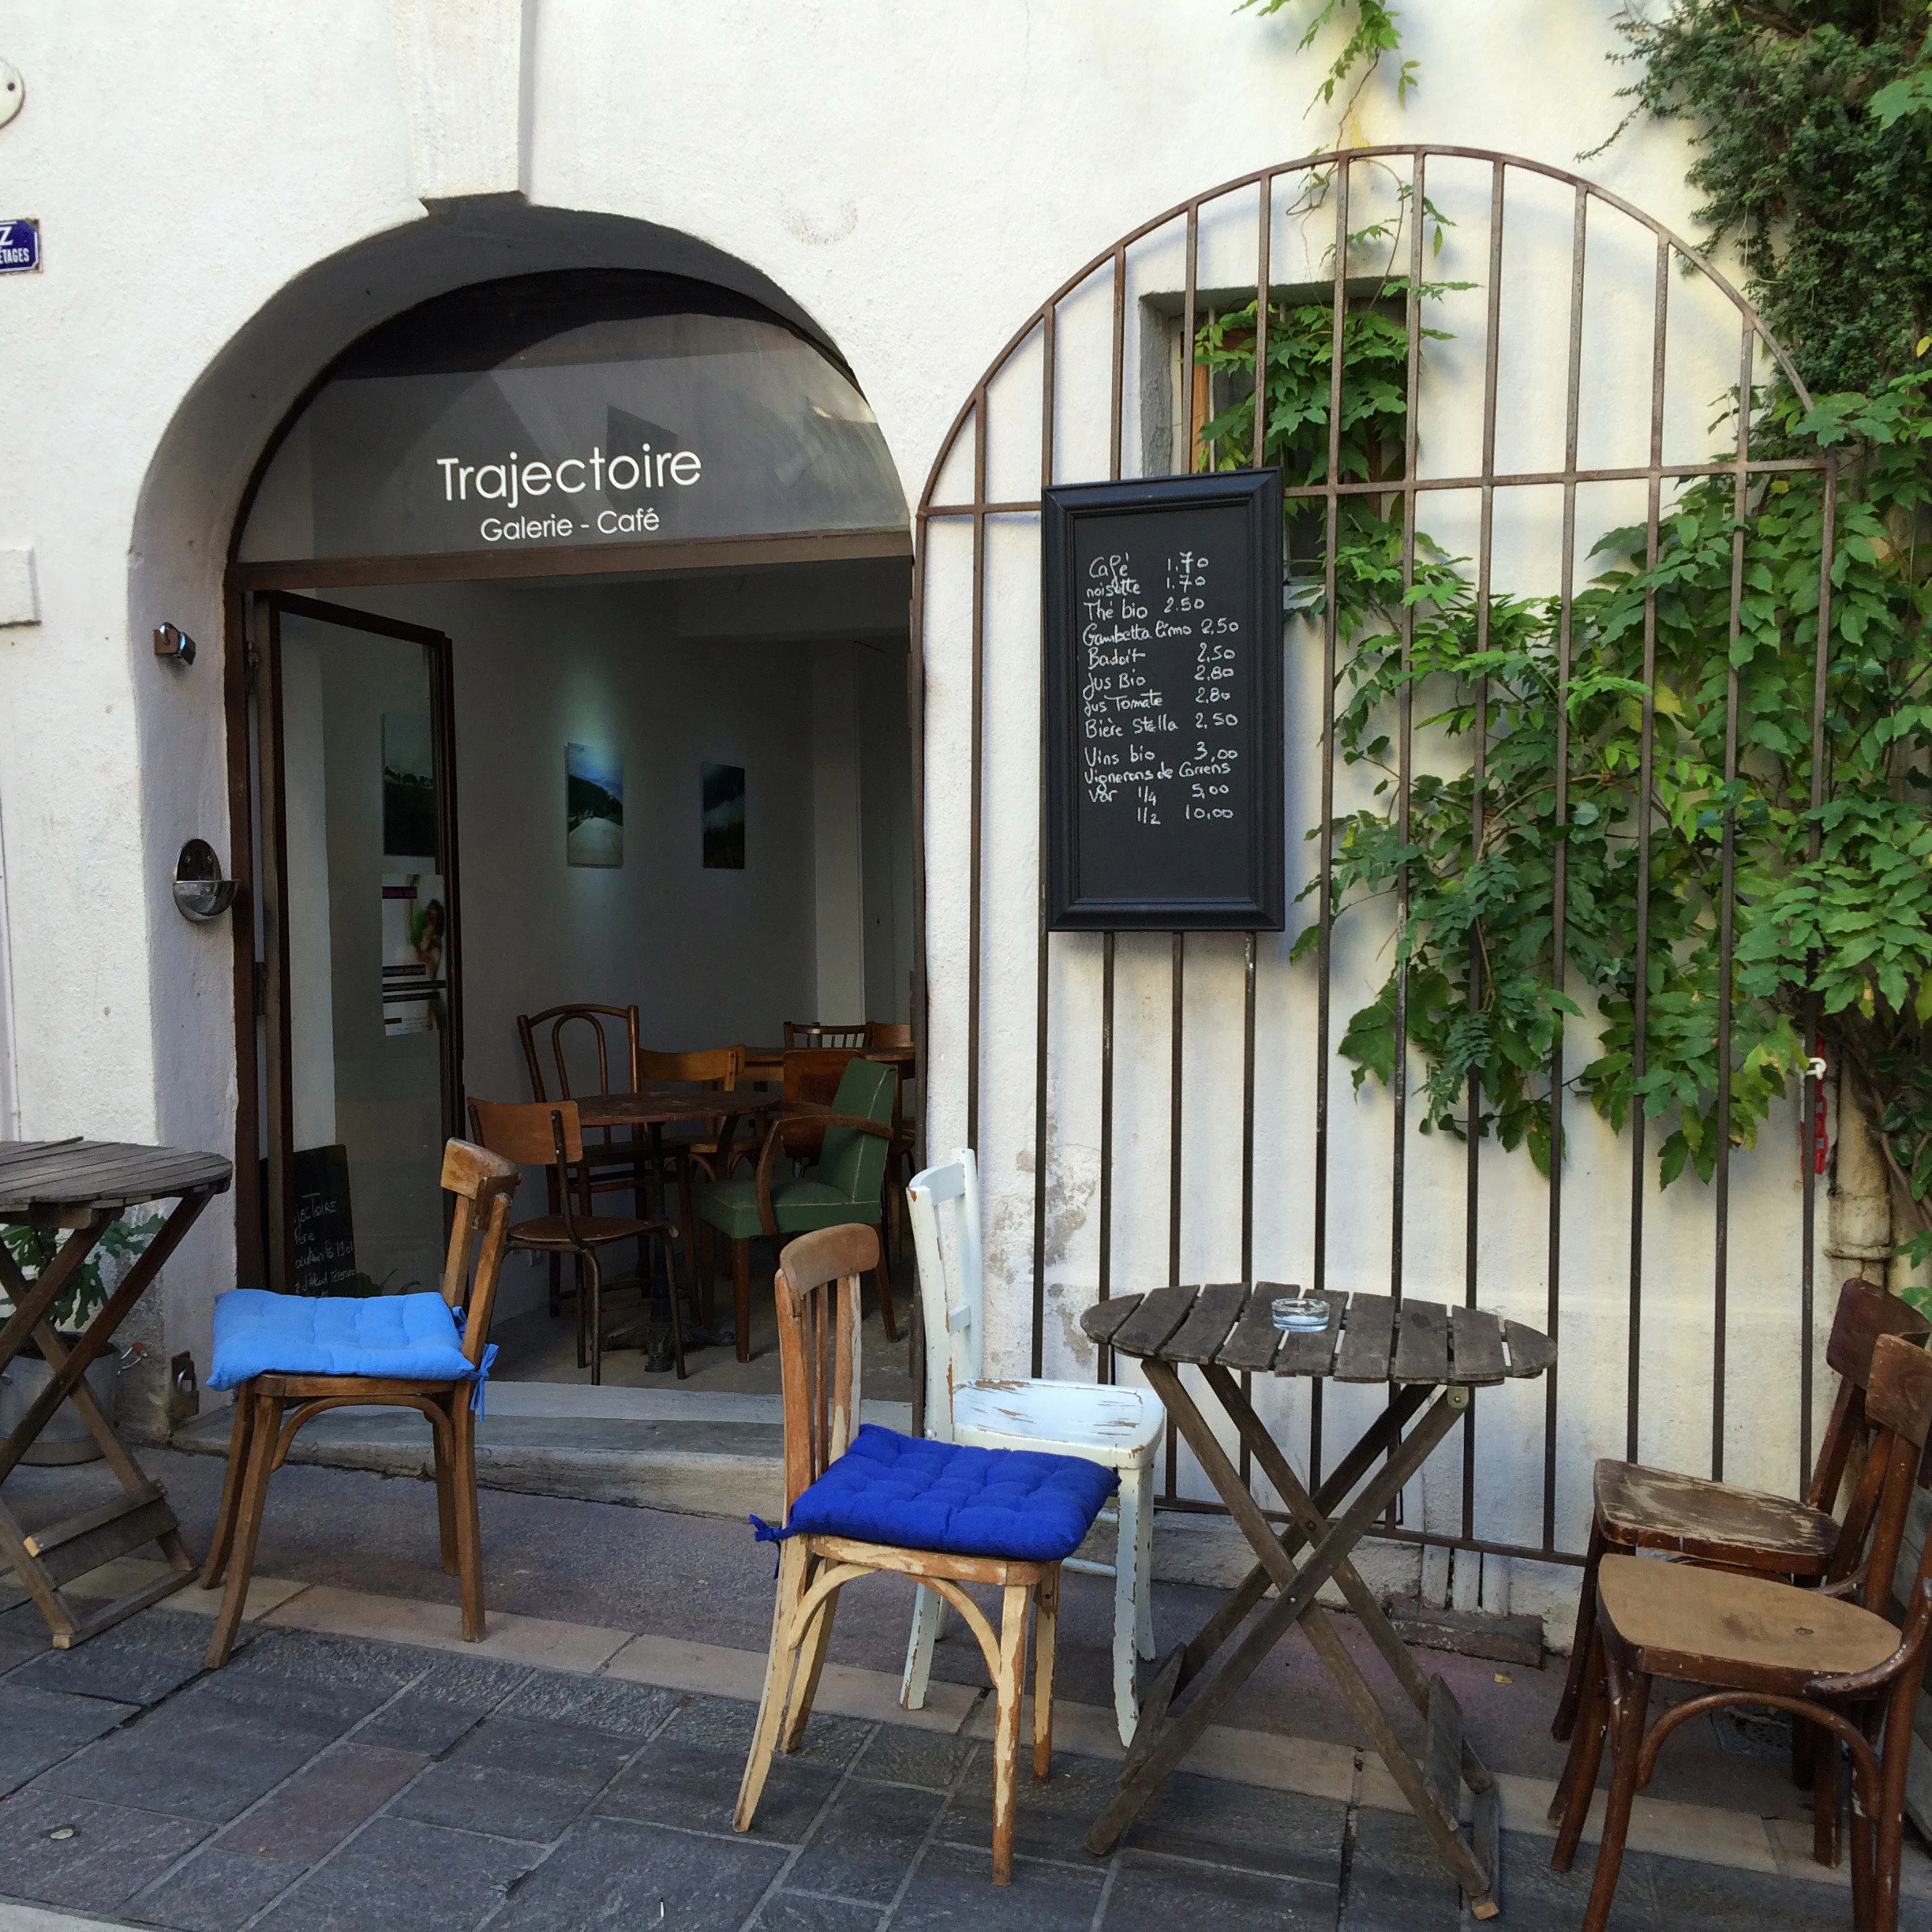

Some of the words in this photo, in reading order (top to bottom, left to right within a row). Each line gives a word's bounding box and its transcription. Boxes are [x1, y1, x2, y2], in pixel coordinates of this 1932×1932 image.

[436, 443, 702, 508] Trajectoire
[481, 514, 573, 541] Galerie
[597, 507, 660, 534] Café
[1121, 598, 1148, 620] bio
[1082, 623, 1152, 646] Gambetta
[1088, 647, 1146, 670] Badoit
[1104, 689, 1163, 711] Tomate
[1085, 717, 1124, 739] Bière
[1132, 713, 1179, 734] Stella
[1084, 747, 1120, 767] Vins
[1130, 744, 1155, 763] bio
[1157, 762, 1174, 780] de
